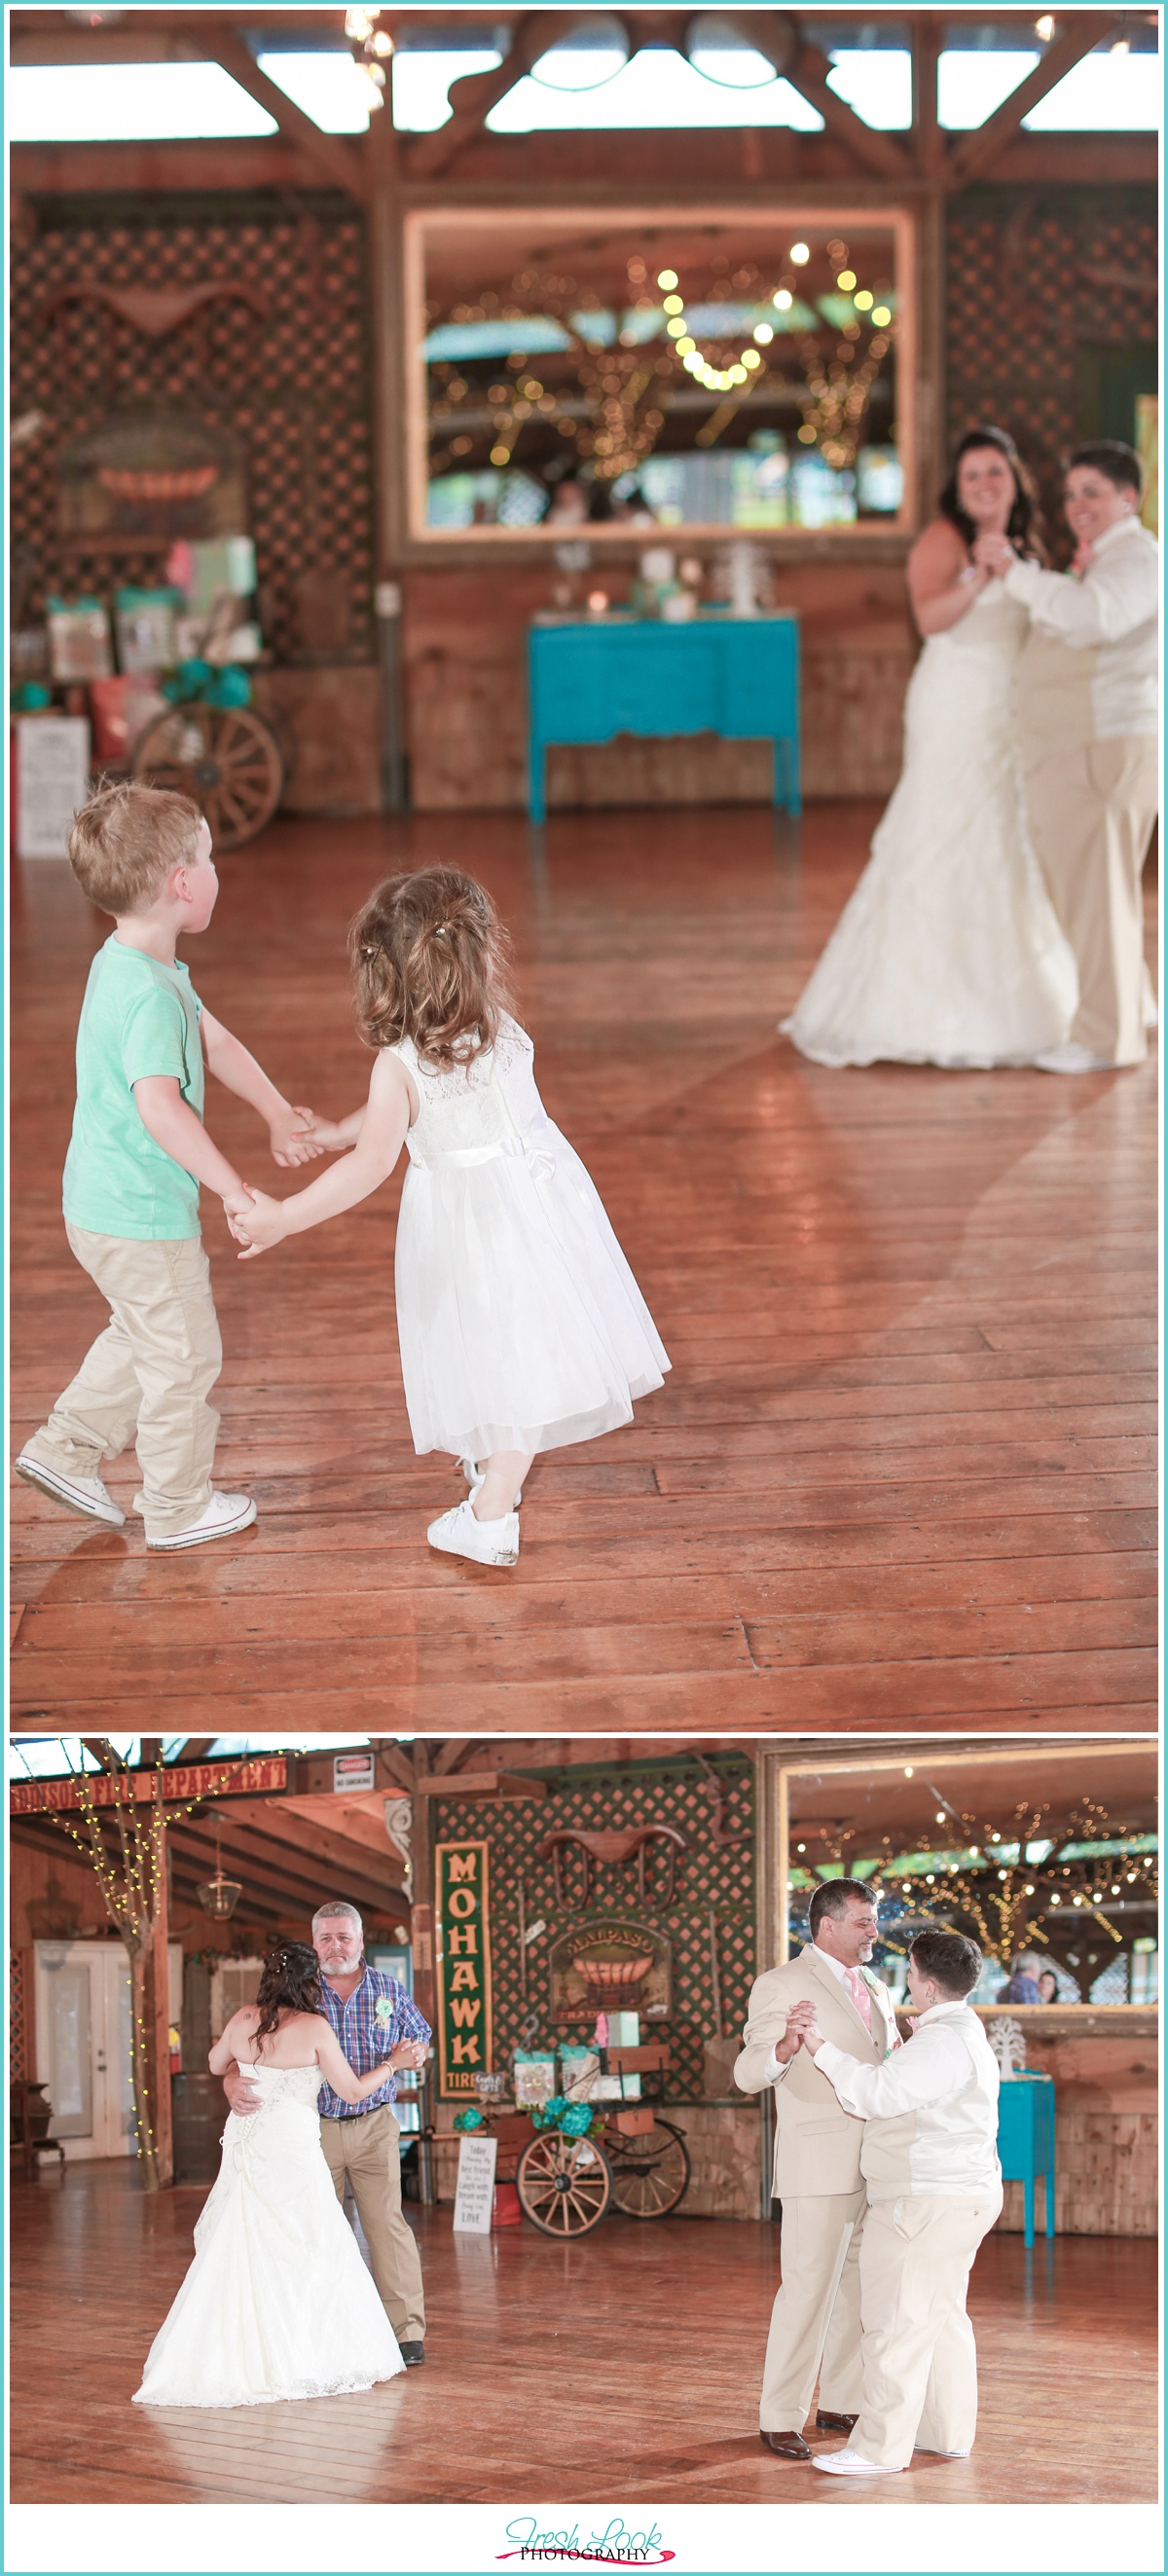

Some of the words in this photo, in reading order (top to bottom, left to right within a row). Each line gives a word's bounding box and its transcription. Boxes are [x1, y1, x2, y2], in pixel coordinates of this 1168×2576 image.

[94, 1775, 136, 1804] FIRE
[150, 1760, 287, 1799] DEPARTMENT
[336, 1778, 344, 1787] NO
[346, 1776, 371, 1786] SMOKING
[448, 1852, 481, 2064] MOHAWK
[461, 2212, 480, 2225] LOVE
